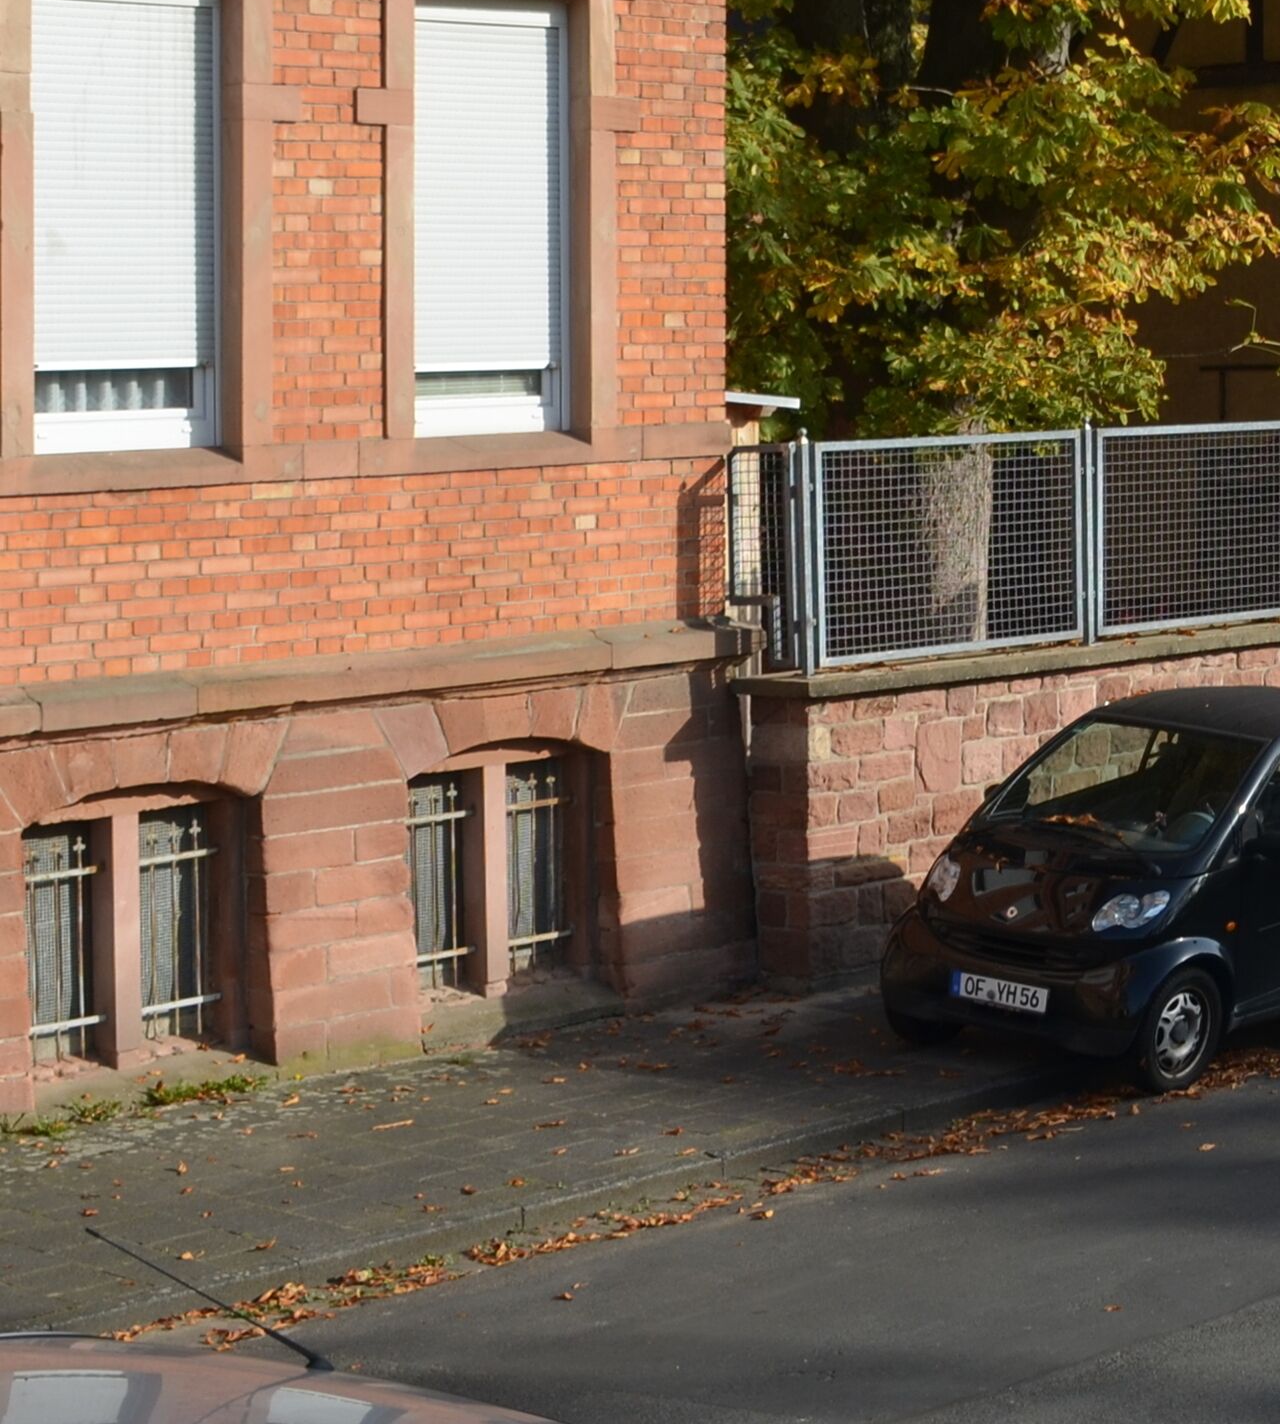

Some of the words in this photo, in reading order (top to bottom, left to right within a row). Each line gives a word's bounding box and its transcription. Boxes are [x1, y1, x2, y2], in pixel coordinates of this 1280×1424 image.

[964, 976, 986, 996] OF
[997, 981, 1018, 1005] YH
[1020, 986, 1040, 1009] 56
